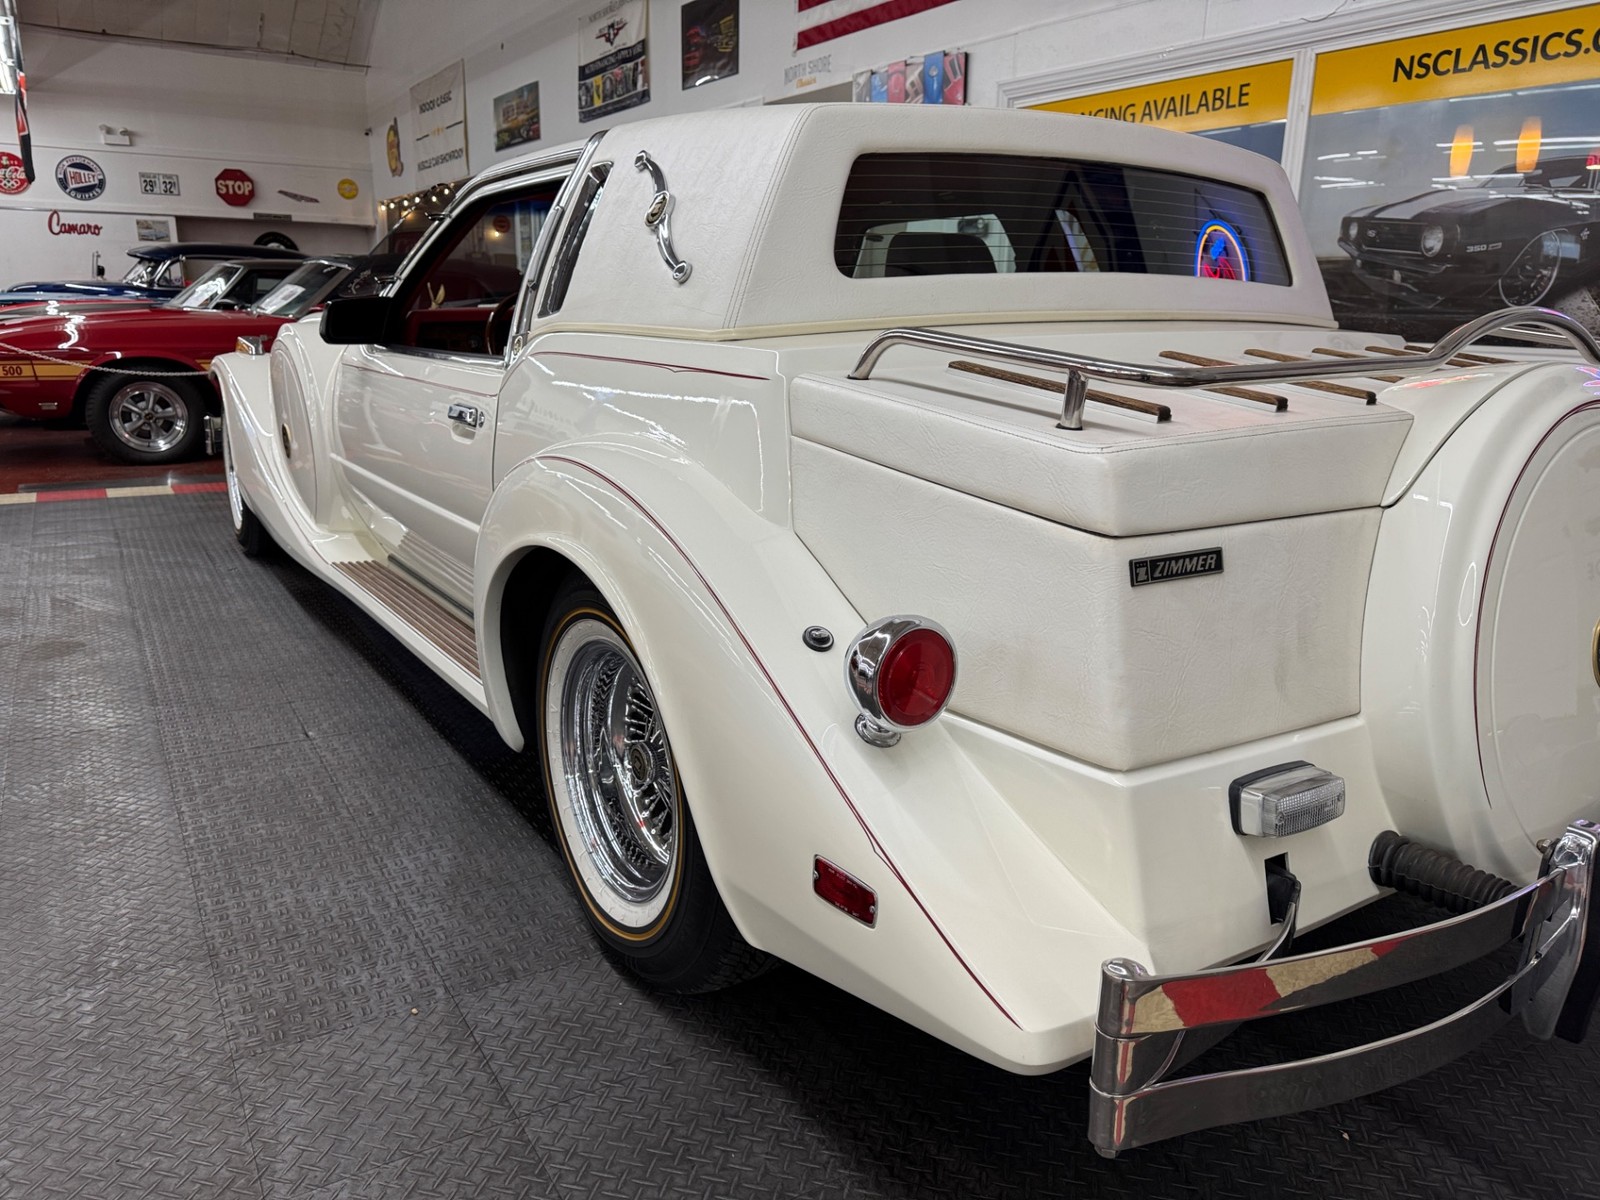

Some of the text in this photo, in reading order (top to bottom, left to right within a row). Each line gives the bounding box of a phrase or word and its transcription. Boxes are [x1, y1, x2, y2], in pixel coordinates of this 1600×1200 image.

[1140, 82, 1251, 123] AVAILABLE
[69, 170, 97, 186] HOLLEY
[217, 180, 253, 196] STOP
[48, 209, 103, 236] Camaro
[1466, 244, 1488, 253] 350
[2, 365, 23, 376] 500
[1153, 554, 1217, 578] ZIMMER
